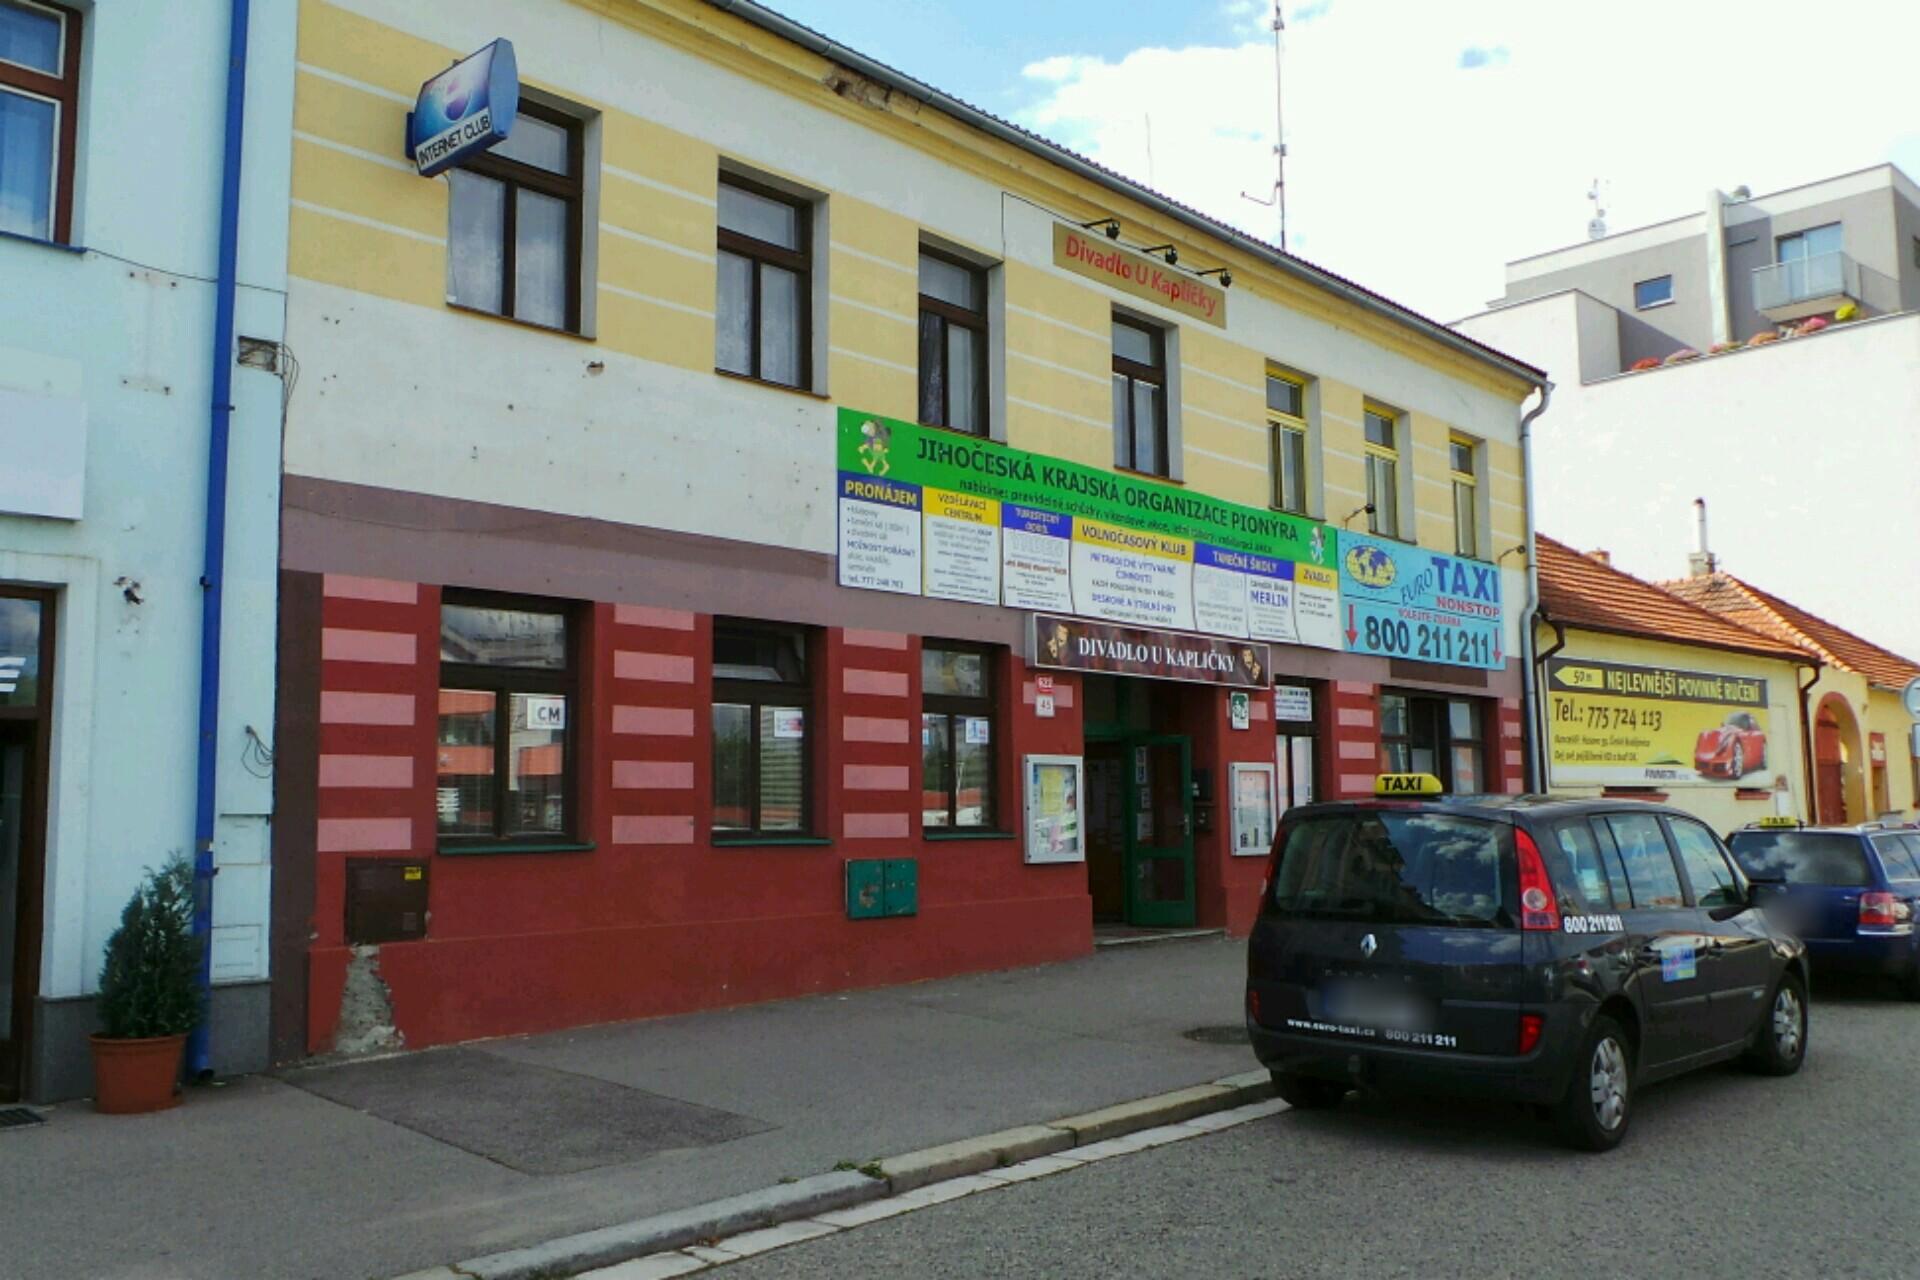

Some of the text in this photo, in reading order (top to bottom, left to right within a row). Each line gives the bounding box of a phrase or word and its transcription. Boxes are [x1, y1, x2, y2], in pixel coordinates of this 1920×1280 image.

[418, 115, 491, 166] INTERNET CLUB
[1065, 234, 1217, 318] Divadlo U Kapličky
[844, 479, 918, 506] PRONÁJEM
[916, 436, 1299, 542] JIHOČESKÁ KRAJSKÁ ORGANIZACE PIONÝRA
[1081, 524, 1158, 550] VOLNOČASOVÝ
[1160, 541, 1187, 555] KLUB
[1431, 556, 1500, 604] TAXI
[1250, 590, 1289, 608] MERLIN
[1435, 595, 1500, 617] NONSTOP
[1078, 637, 1236, 673] DIVADLO U KAPLIČKY
[1364, 615, 1489, 665] 800 211 211
[1607, 669, 1676, 698] NEJLEVNĚJŠÍ
[1678, 675, 1723, 700] POVINNÉ
[1724, 679, 1760, 702] RUČENÍ
[536, 706, 561, 722] CM
[1554, 698, 1663, 732] Tel.: 775 724 113
[1382, 775, 1423, 791] TAXI
[1765, 816, 1790, 825] TAXI
[1563, 913, 1625, 934] 800 211 211
[1385, 1028, 1410, 1042] 800
[1411, 1031, 1433, 1045] 211
[1434, 1033, 1457, 1048] 211
